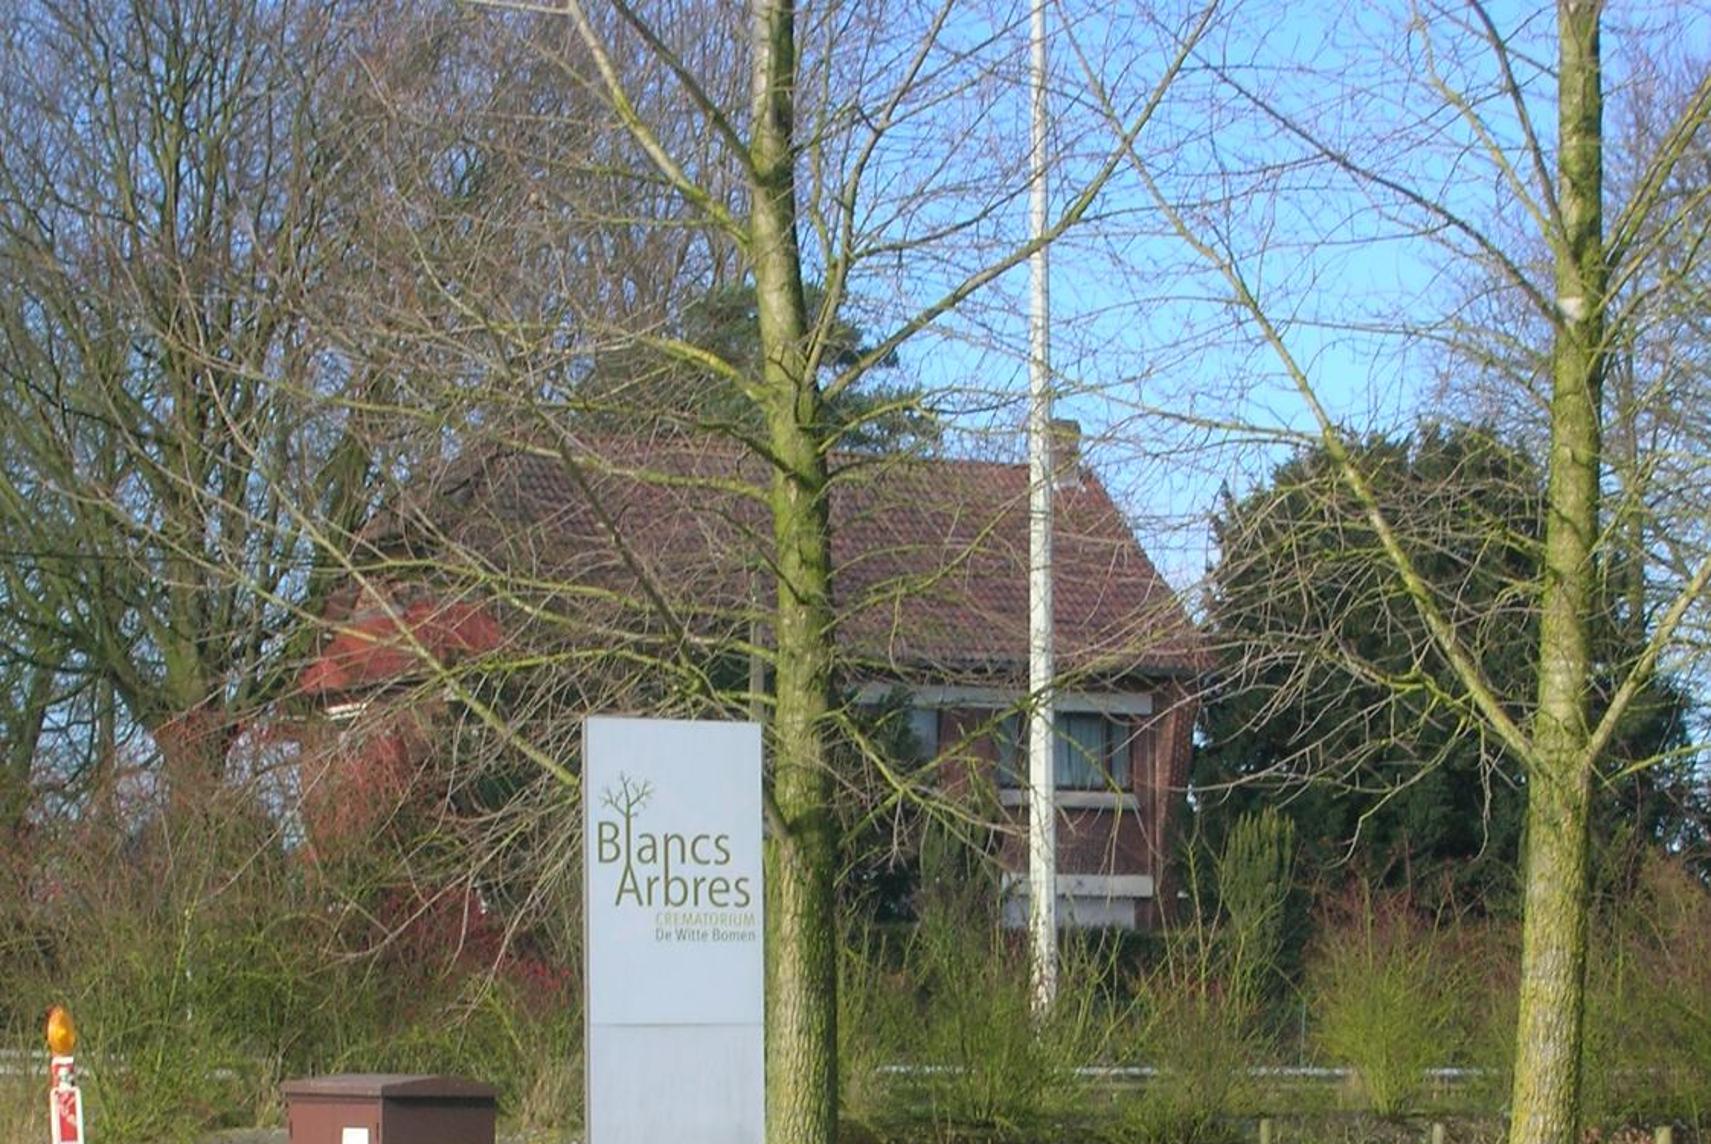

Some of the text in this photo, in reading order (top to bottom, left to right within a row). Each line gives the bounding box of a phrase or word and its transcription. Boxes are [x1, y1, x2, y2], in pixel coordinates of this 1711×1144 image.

[598, 820, 731, 866] Blancs
[615, 863, 751, 908] Arbres
[656, 912, 756, 926] CREMATORIUM
[656, 928, 756, 942] De Witte Bomen
